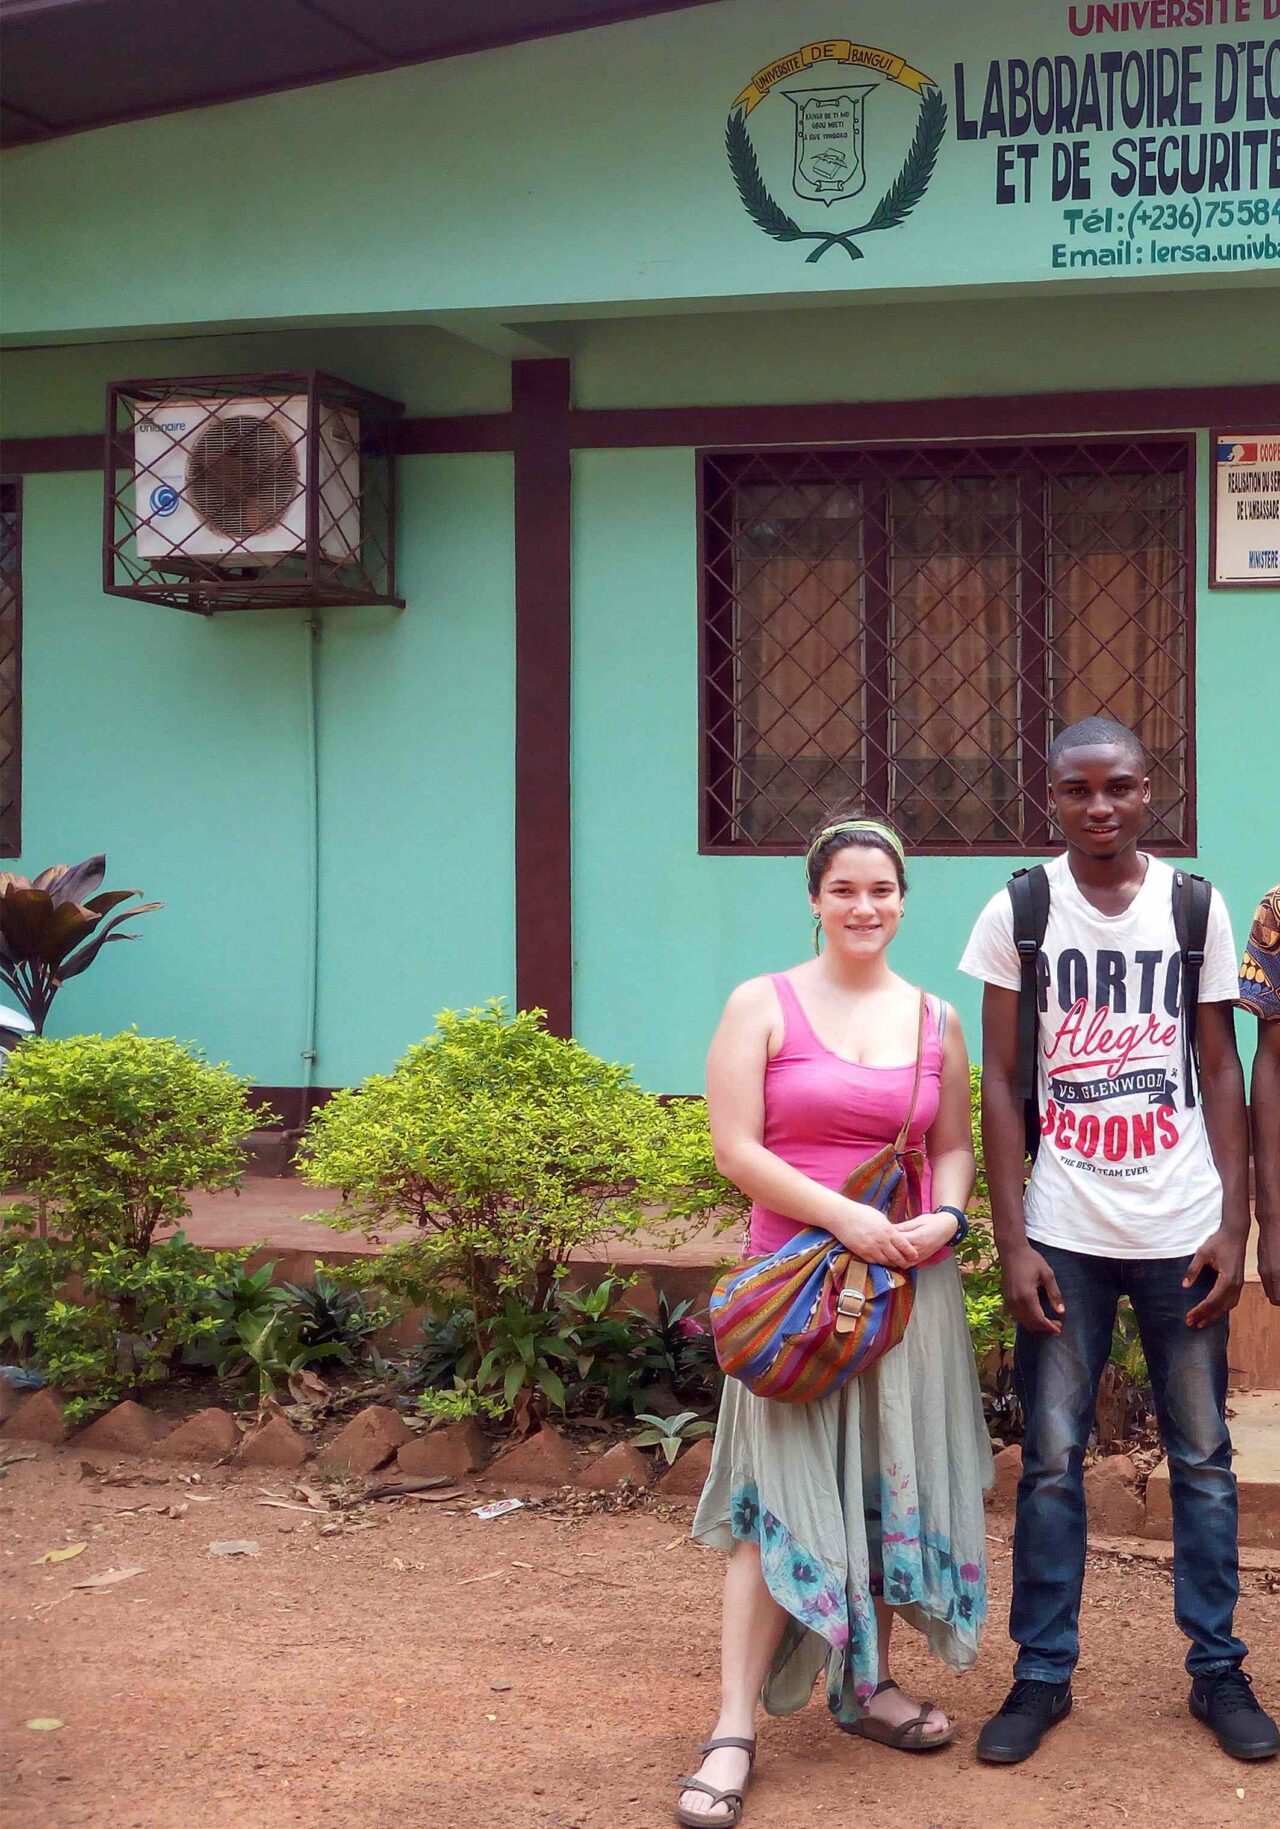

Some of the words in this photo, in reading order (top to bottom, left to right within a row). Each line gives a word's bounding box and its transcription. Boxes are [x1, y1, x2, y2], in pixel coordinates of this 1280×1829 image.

[756, 57, 801, 90] UNIVERSITE
[811, 43, 837, 60] DE
[852, 48, 894, 70] BANGUI
[954, 44, 1203, 140] LABORATOIRE
[996, 144, 1039, 204] ET
[1051, 140, 1091, 202] DE
[1237, 501, 1243, 520] DE
[1249, 550, 1278, 568] MINISTERE
[1044, 998, 1177, 1079] Alegre
[1059, 1084, 1079, 1100] VS.
[1081, 1073, 1164, 1099] GLENWOOD
[1060, 1155, 1076, 1166] THE
[1076, 1160, 1096, 1172] BEST
[1098, 1168, 1123, 1177] TEAM
[1125, 1166, 1149, 1177] EVER
